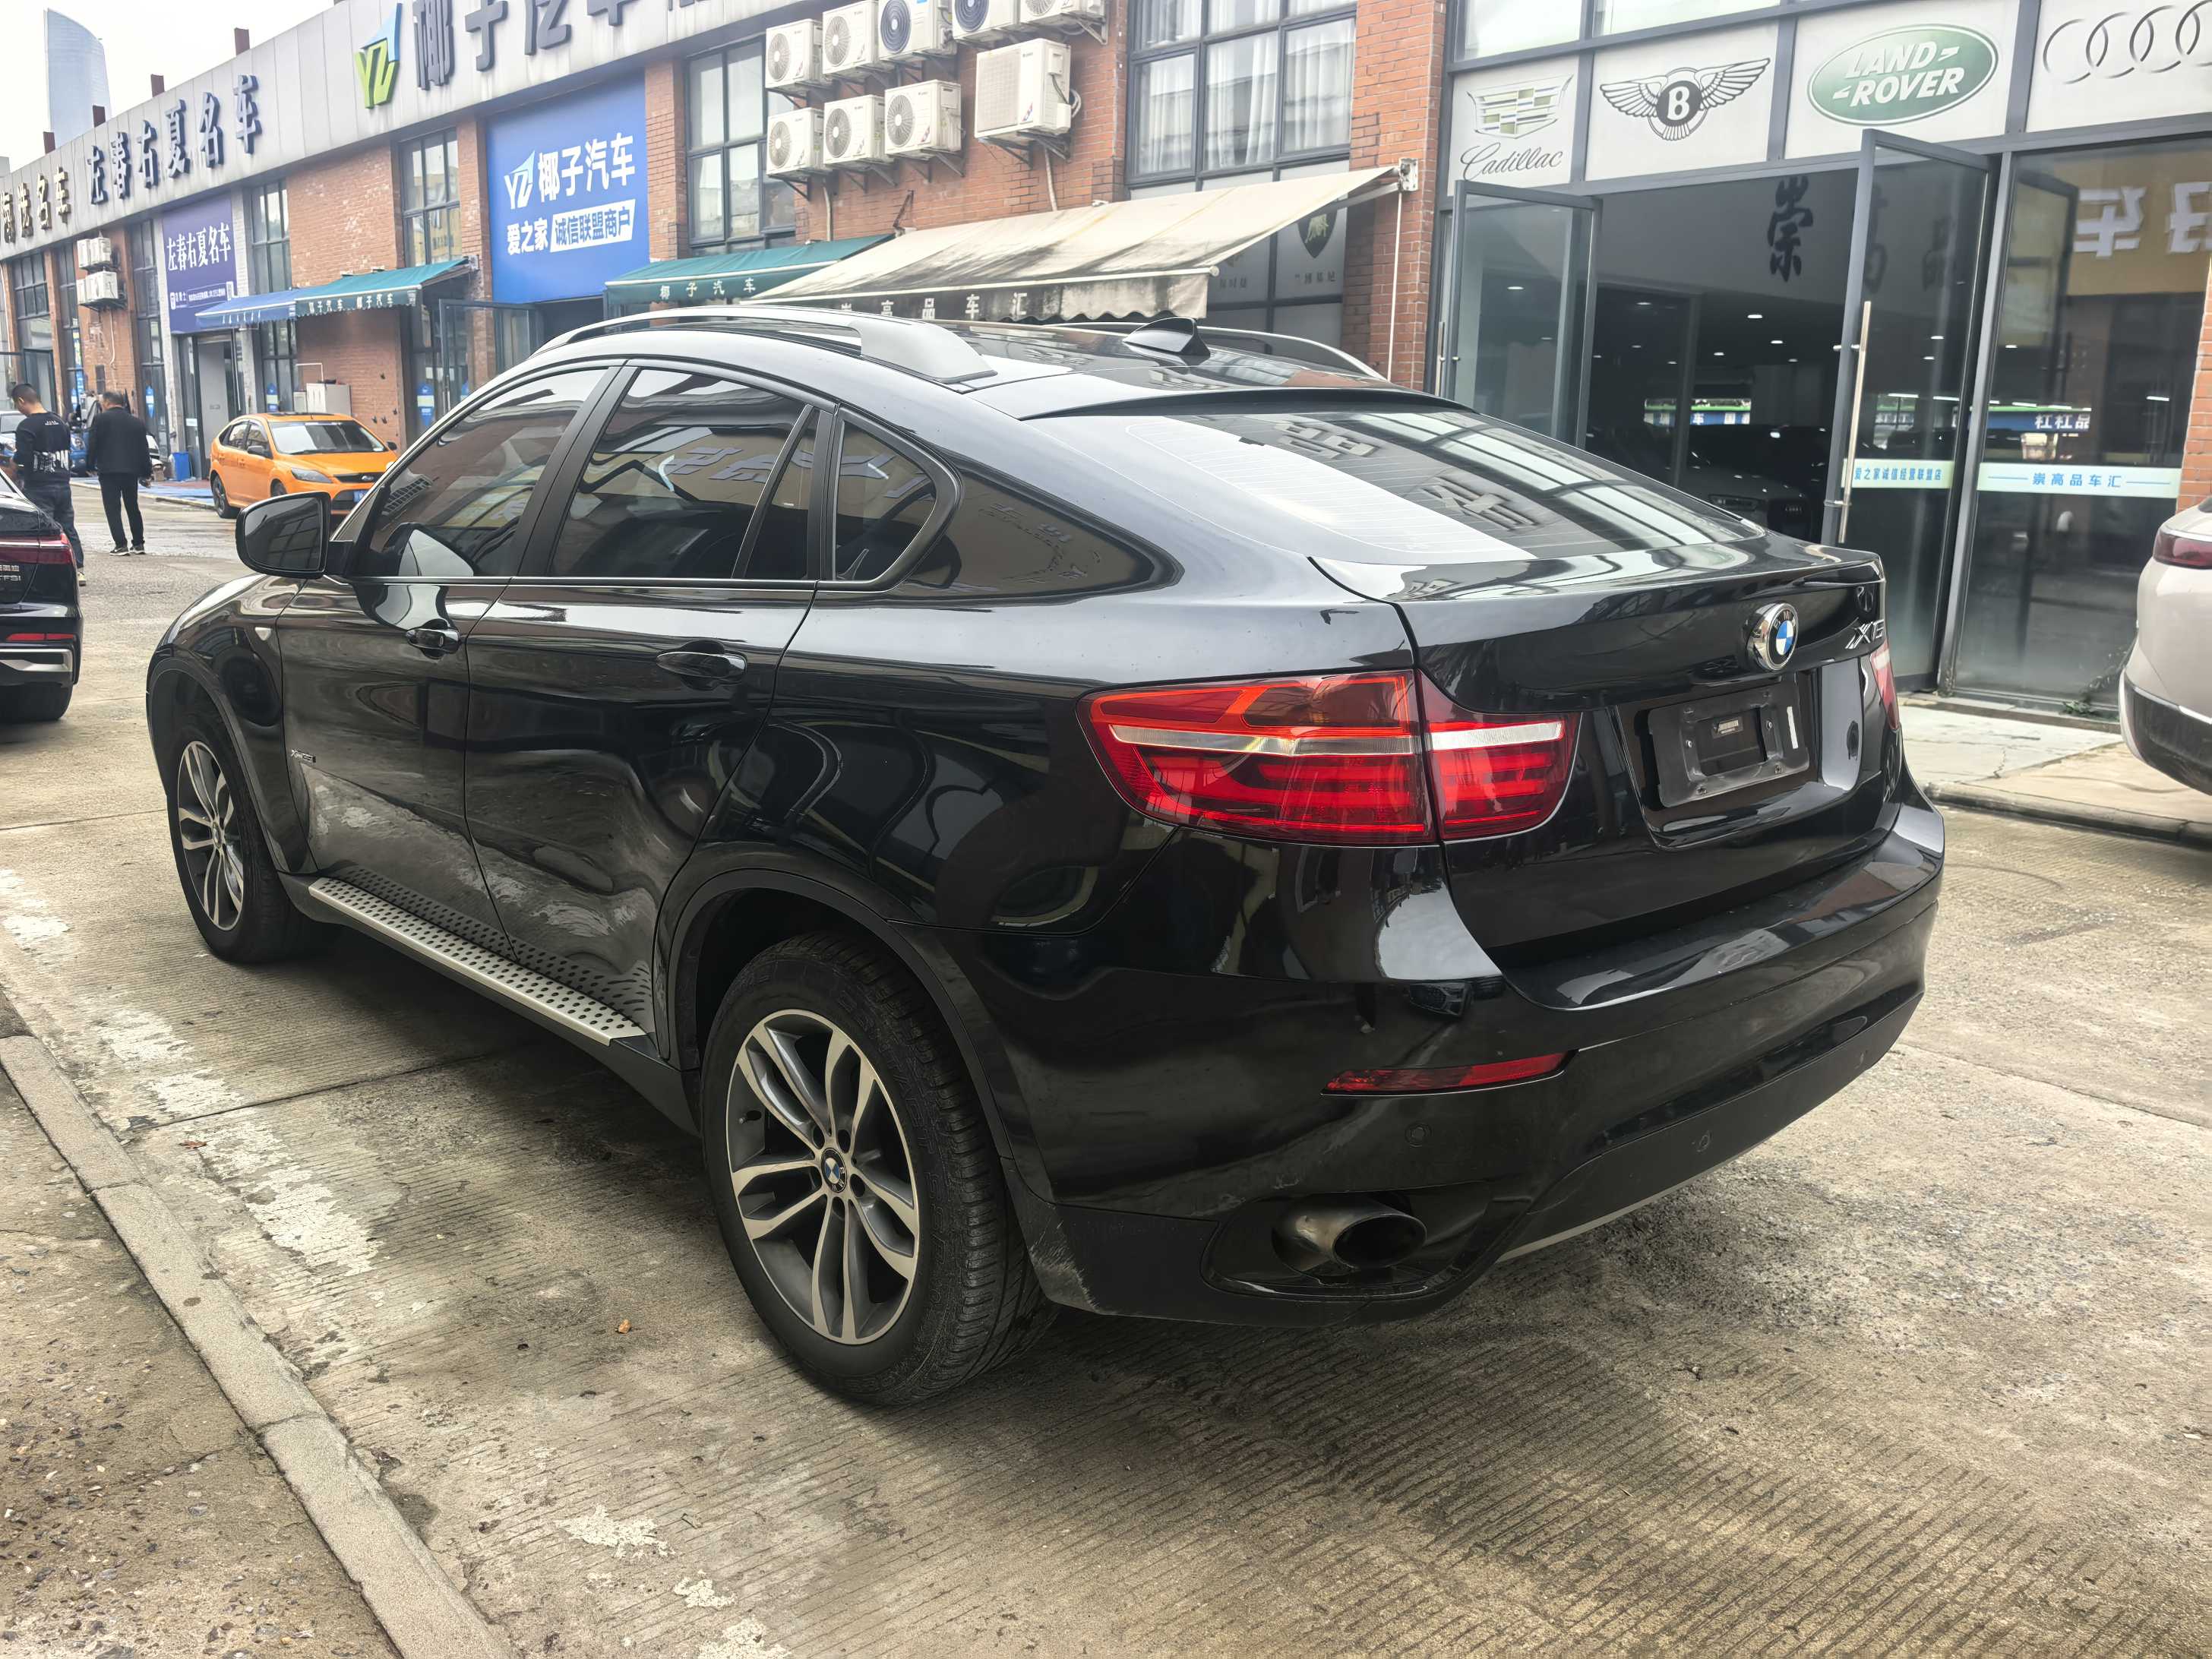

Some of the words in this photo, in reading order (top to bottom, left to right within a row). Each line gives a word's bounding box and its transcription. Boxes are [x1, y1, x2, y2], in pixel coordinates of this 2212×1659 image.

[1844, 41, 1938, 80] LAND
[1667, 86, 1690, 121] B
[1850, 68, 1964, 107] ROVER
[87, 74, 262, 205] 左春右夏名车
[538, 132, 636, 203] 椰子汽车
[1461, 142, 1563, 181] Cadillac
[166, 222, 232, 271] 左春右夏名车
[507, 217, 548, 255] 爱之家
[555, 207, 631, 246] 诚信联盟商户
[659, 277, 757, 300] 椰子汽车
[1854, 467, 1942, 481] 爱之家诚信经营联盟店
[2032, 472, 2122, 488] 崇高品车汇
